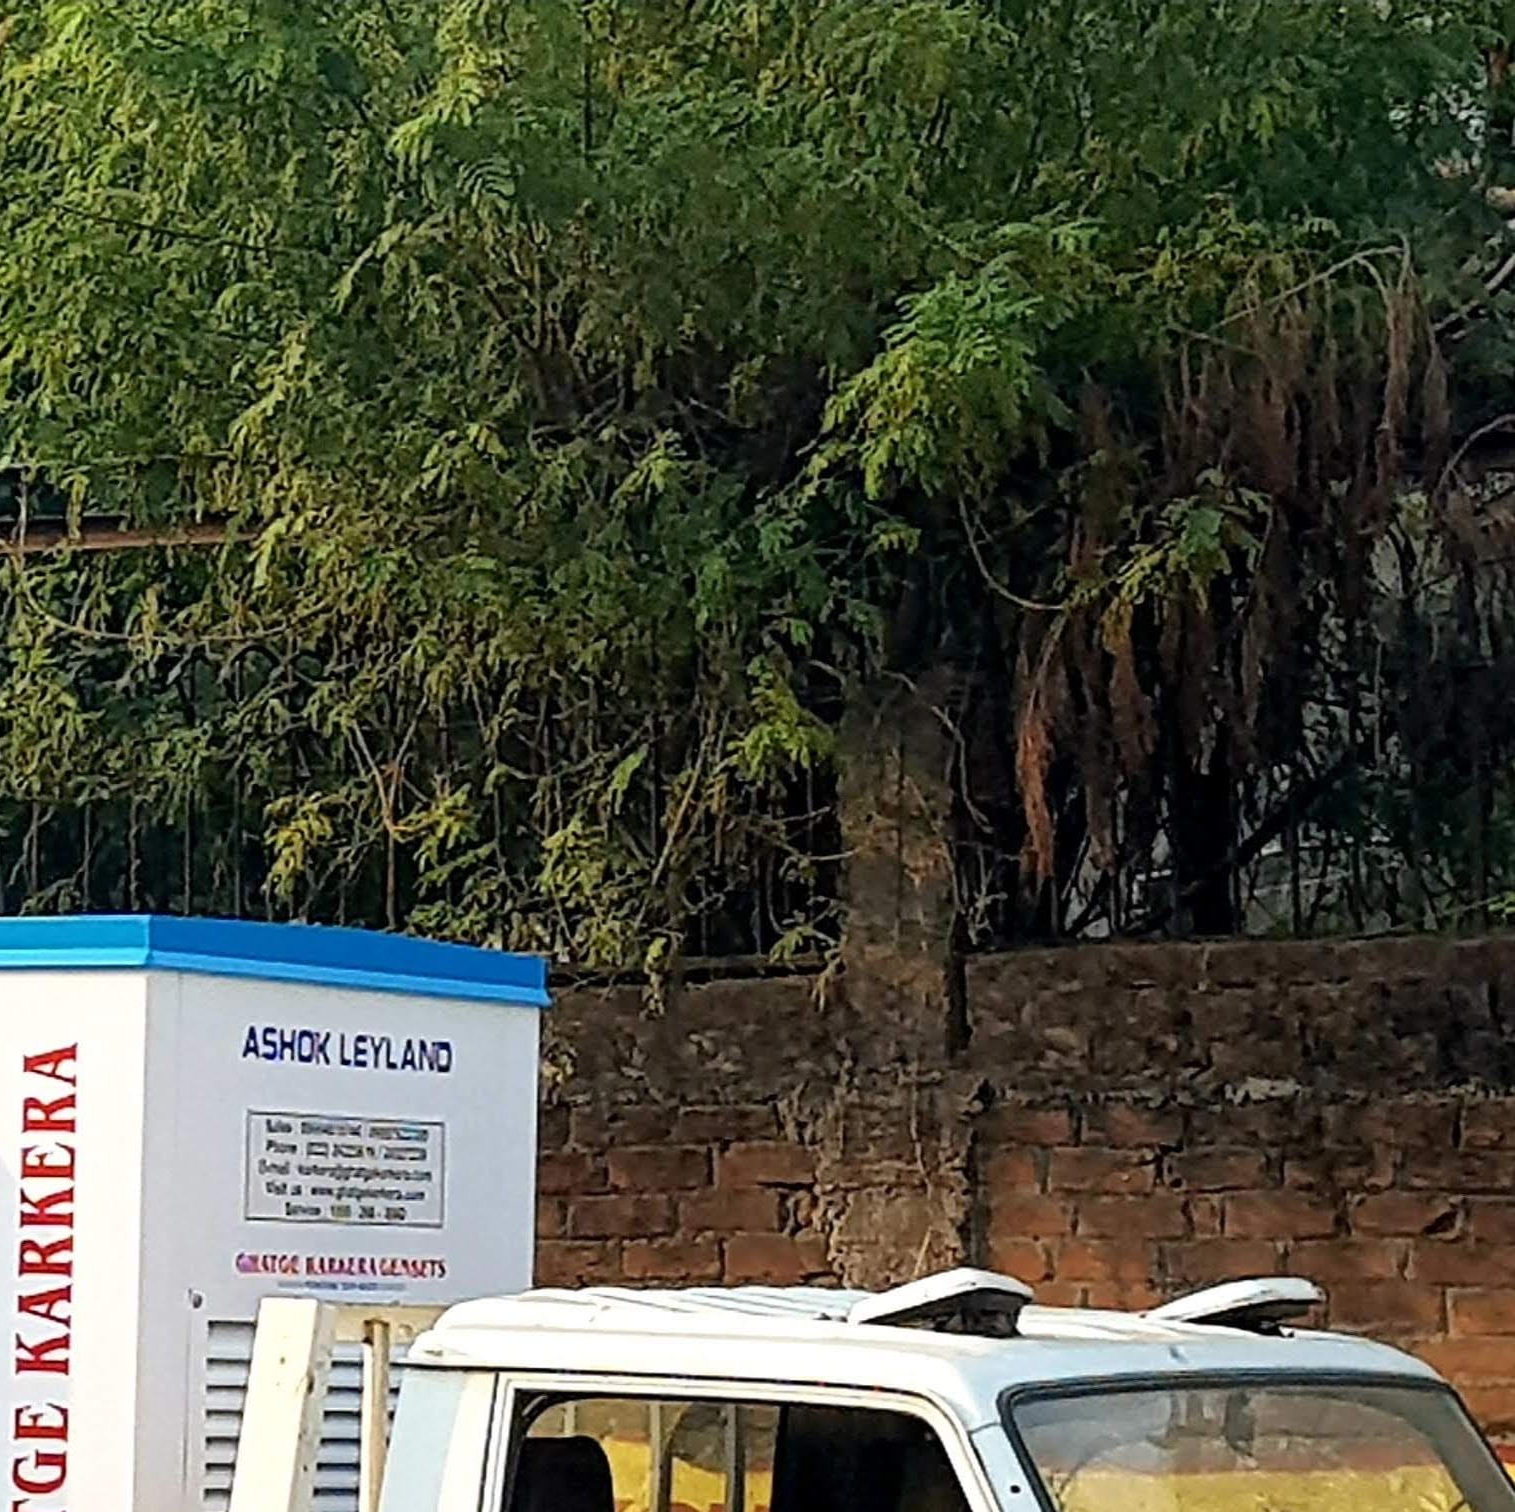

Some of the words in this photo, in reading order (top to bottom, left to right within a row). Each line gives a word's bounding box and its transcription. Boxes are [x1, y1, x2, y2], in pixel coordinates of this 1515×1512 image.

[241, 1025, 331, 1066] ASHOK
[339, 1032, 453, 1073] LEYLAND
[14, 1042, 78, 1376] KARKERA
